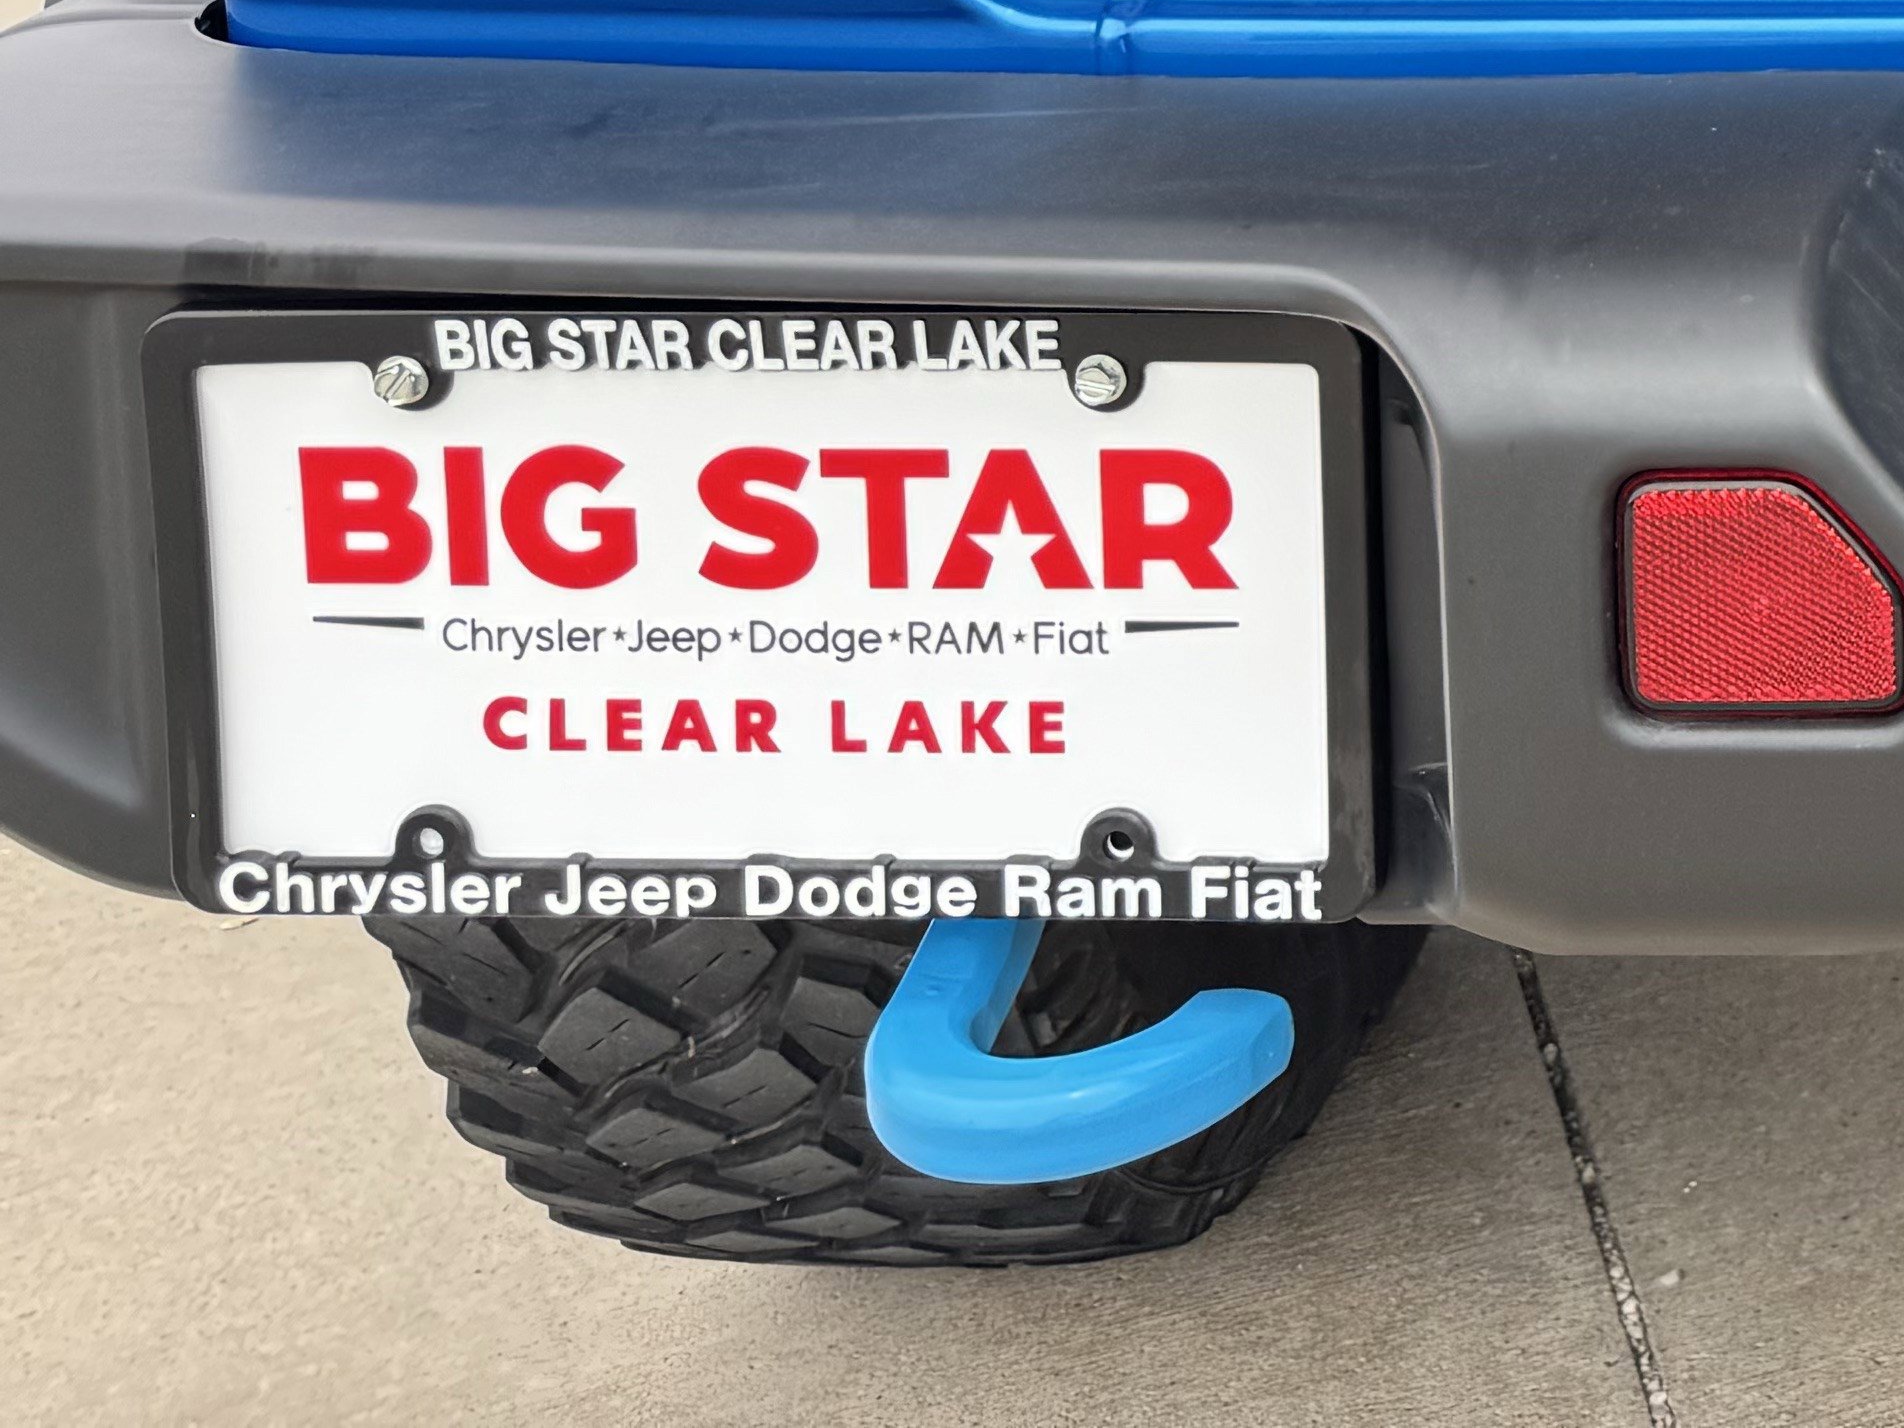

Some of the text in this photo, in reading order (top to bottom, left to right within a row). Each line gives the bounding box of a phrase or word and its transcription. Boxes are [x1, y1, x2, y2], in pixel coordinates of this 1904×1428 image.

[434, 317, 1062, 371] BIG STAR CLEAR LAKE
[298, 445, 1238, 591] BIG STAR
[442, 618, 1109, 662] Chrysler Jeep Dodge RAM Fiat
[482, 695, 1066, 754] CLEAR LAKE
[218, 861, 1323, 921] Chrysler Jeep Dodge Ram Fiat
